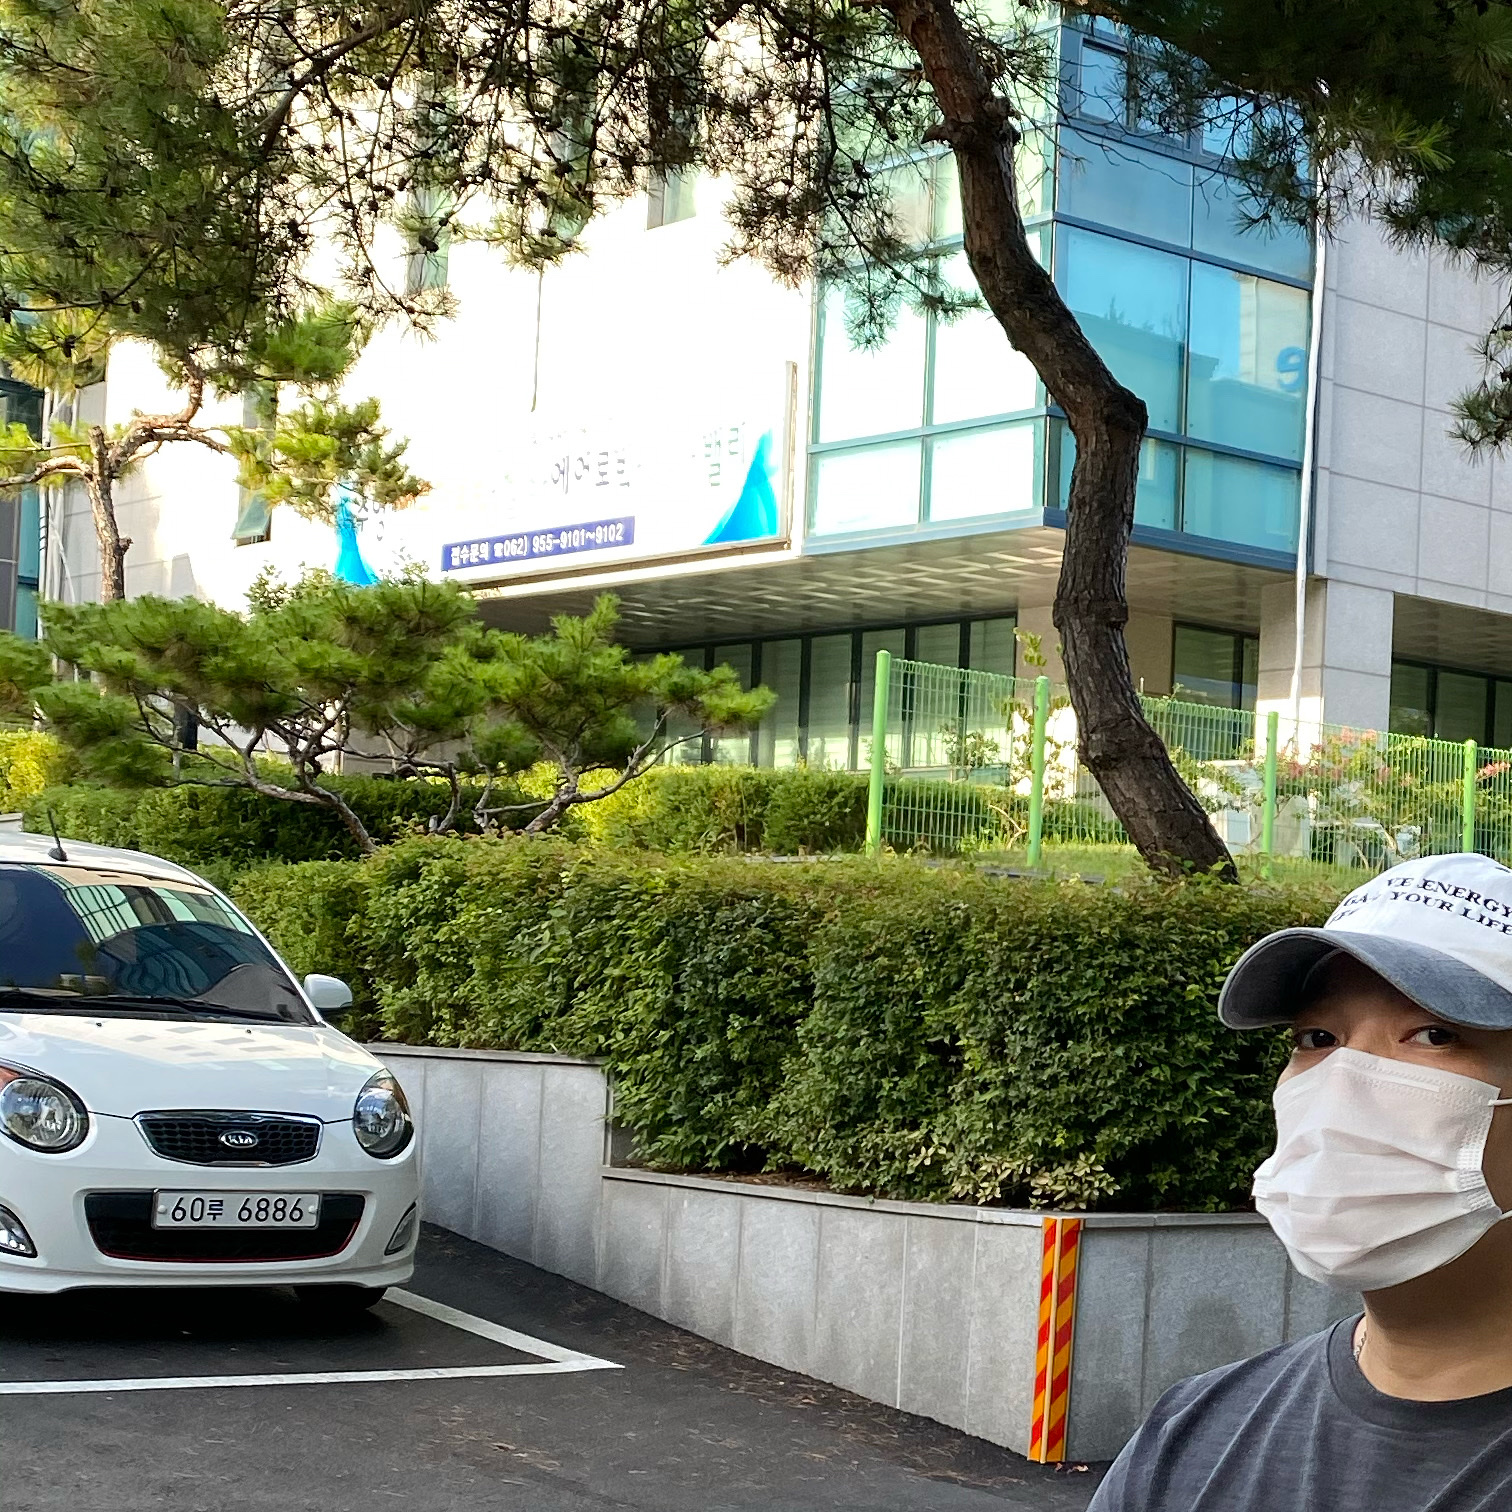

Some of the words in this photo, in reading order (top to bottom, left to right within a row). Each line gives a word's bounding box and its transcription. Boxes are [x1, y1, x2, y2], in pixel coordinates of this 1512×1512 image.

[532, 522, 624, 553] 955-9101~9102
[1390, 891, 1454, 912] YOUR
[171, 1197, 224, 1222] 60루
[237, 1197, 304, 1222] 6886
